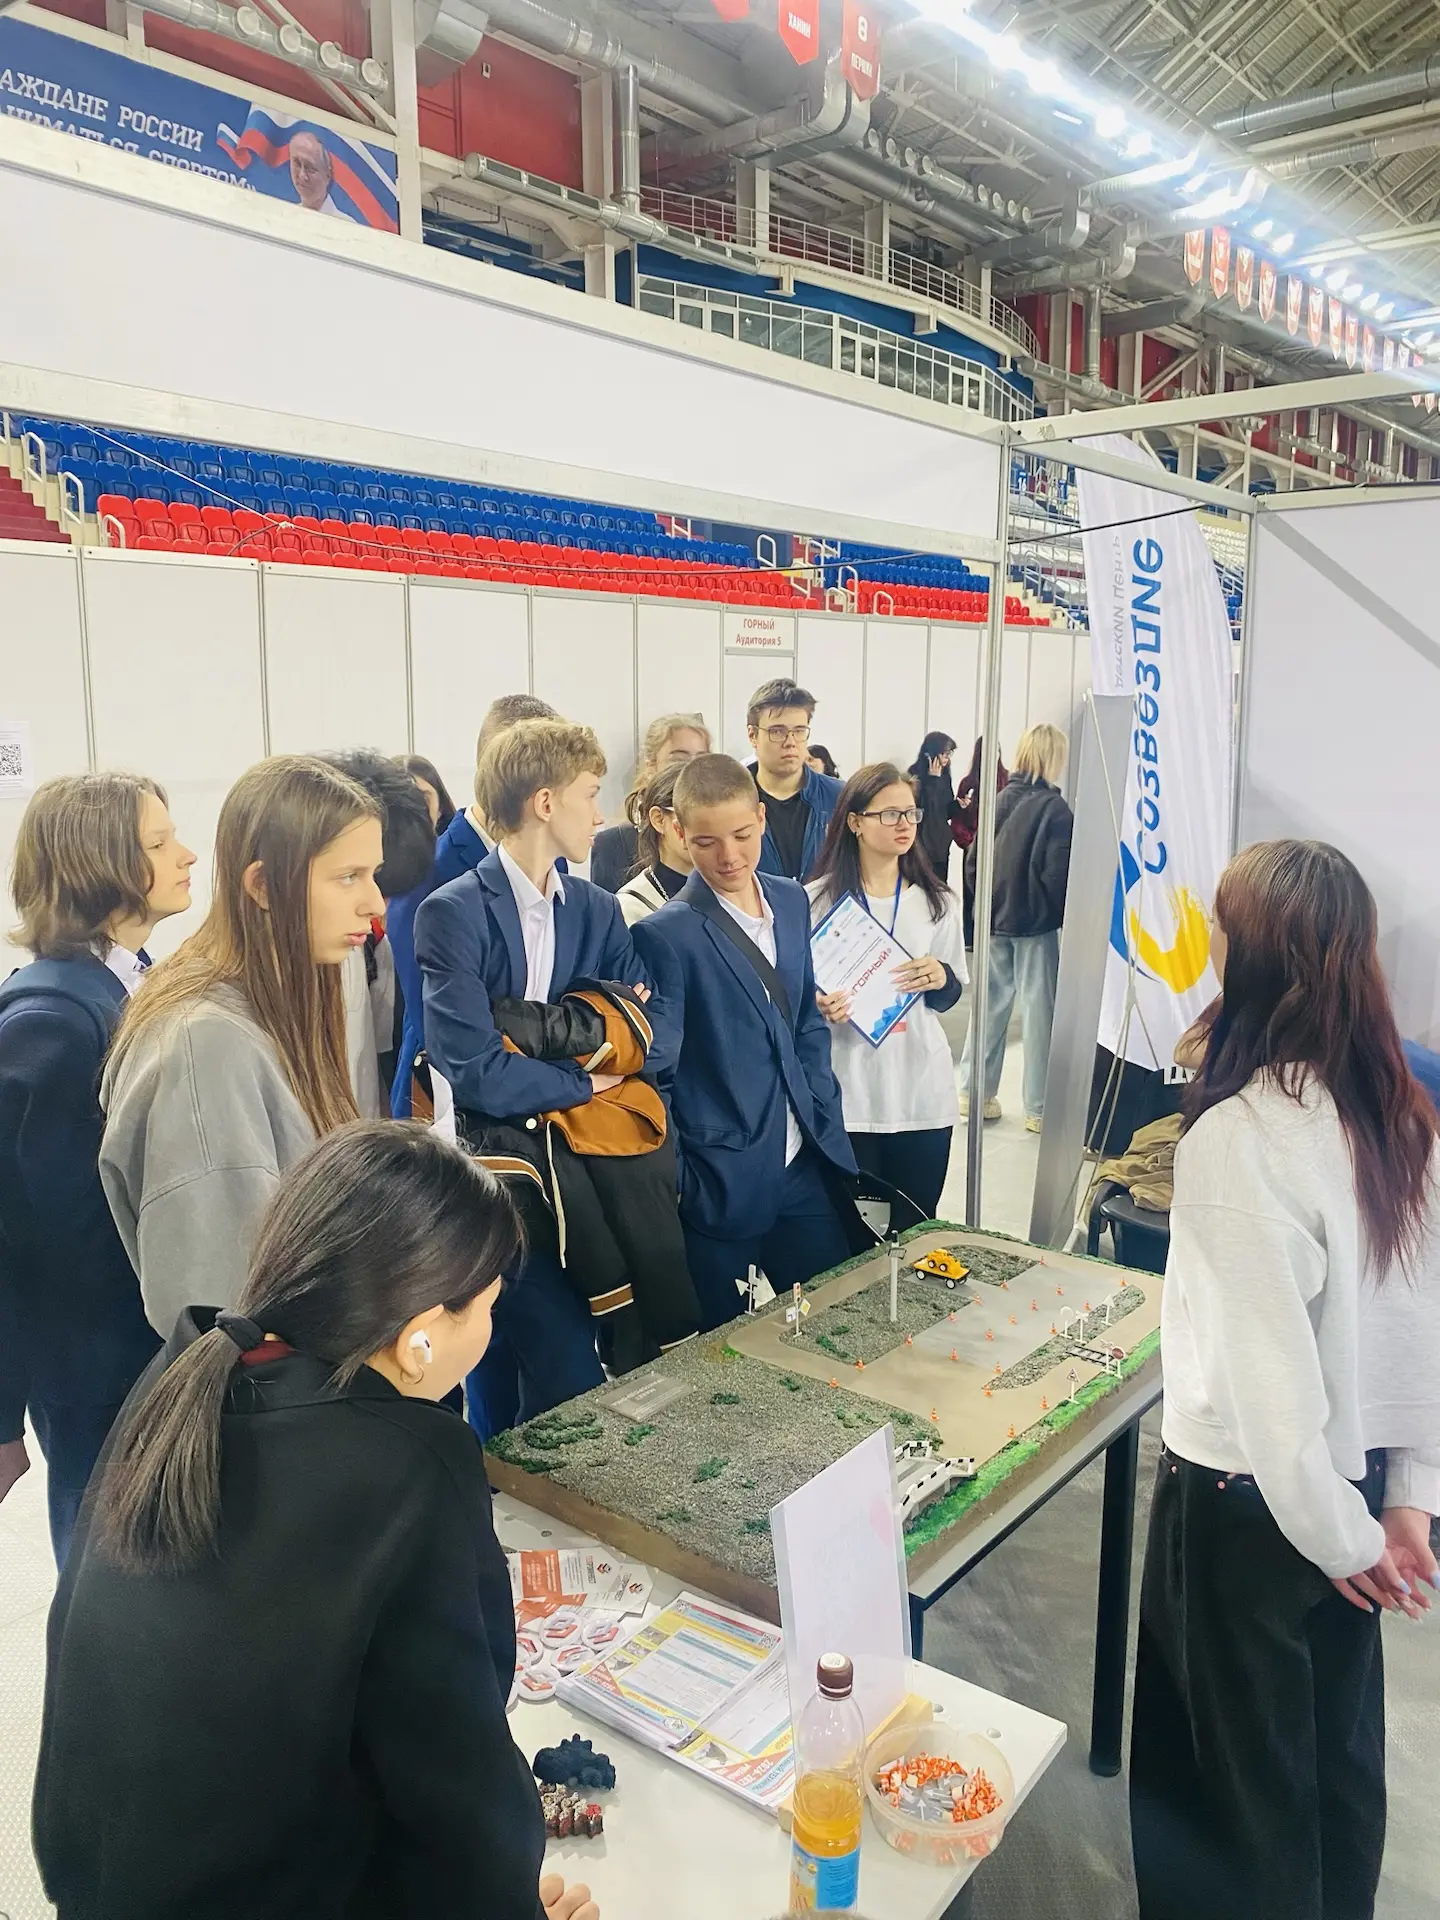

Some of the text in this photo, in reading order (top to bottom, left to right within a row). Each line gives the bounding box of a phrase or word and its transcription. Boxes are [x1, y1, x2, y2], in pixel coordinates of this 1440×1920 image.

[857, 15, 868, 42] 8
[117, 104, 204, 153] РОССИИ
[743, 618, 775, 630] ГОРНЫЙ
[736, 633, 782, 647] Аудитория 5
